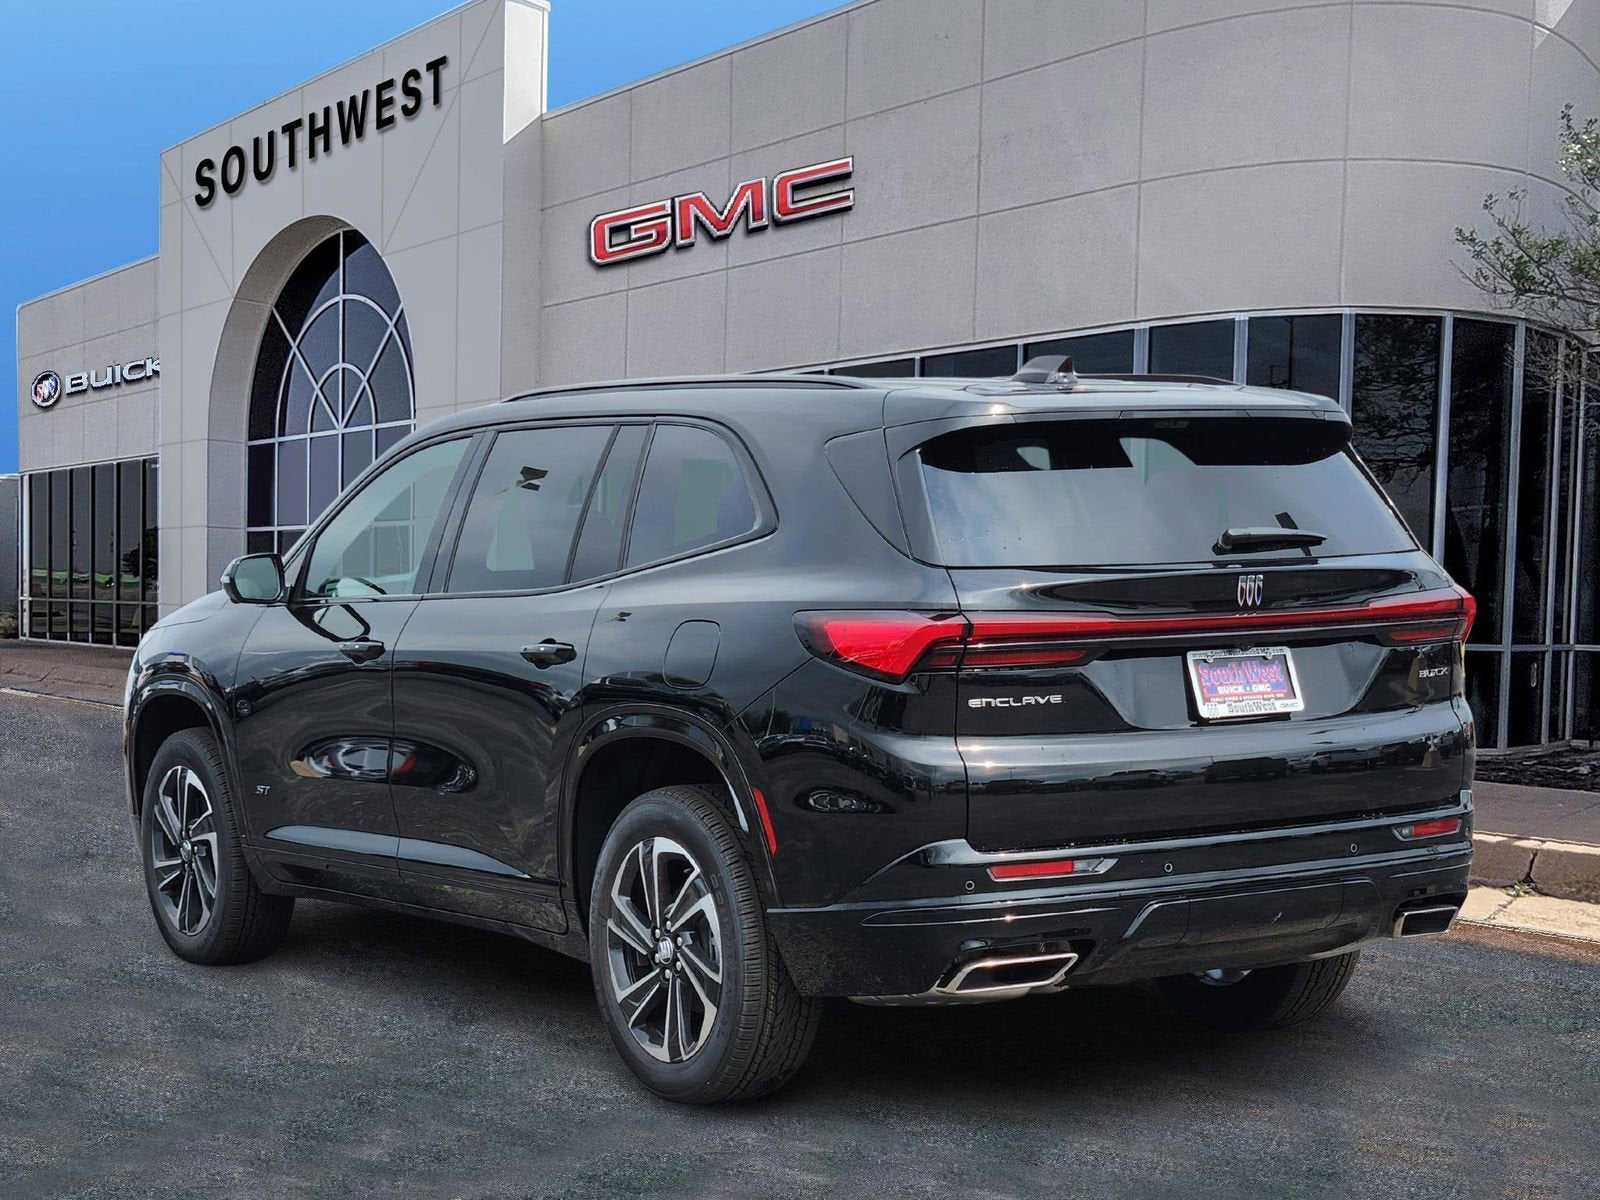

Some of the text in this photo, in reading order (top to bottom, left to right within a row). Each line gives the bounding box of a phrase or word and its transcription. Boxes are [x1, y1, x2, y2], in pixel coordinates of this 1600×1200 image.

[194, 55, 448, 208] SOUTHWEST
[588, 155, 855, 266] GMC
[64, 356, 161, 396] BUICK
[1418, 666, 1449, 678] BUICK
[967, 694, 1063, 708] ENCLAVE
[1216, 682, 1272, 695] BUICK GMC
